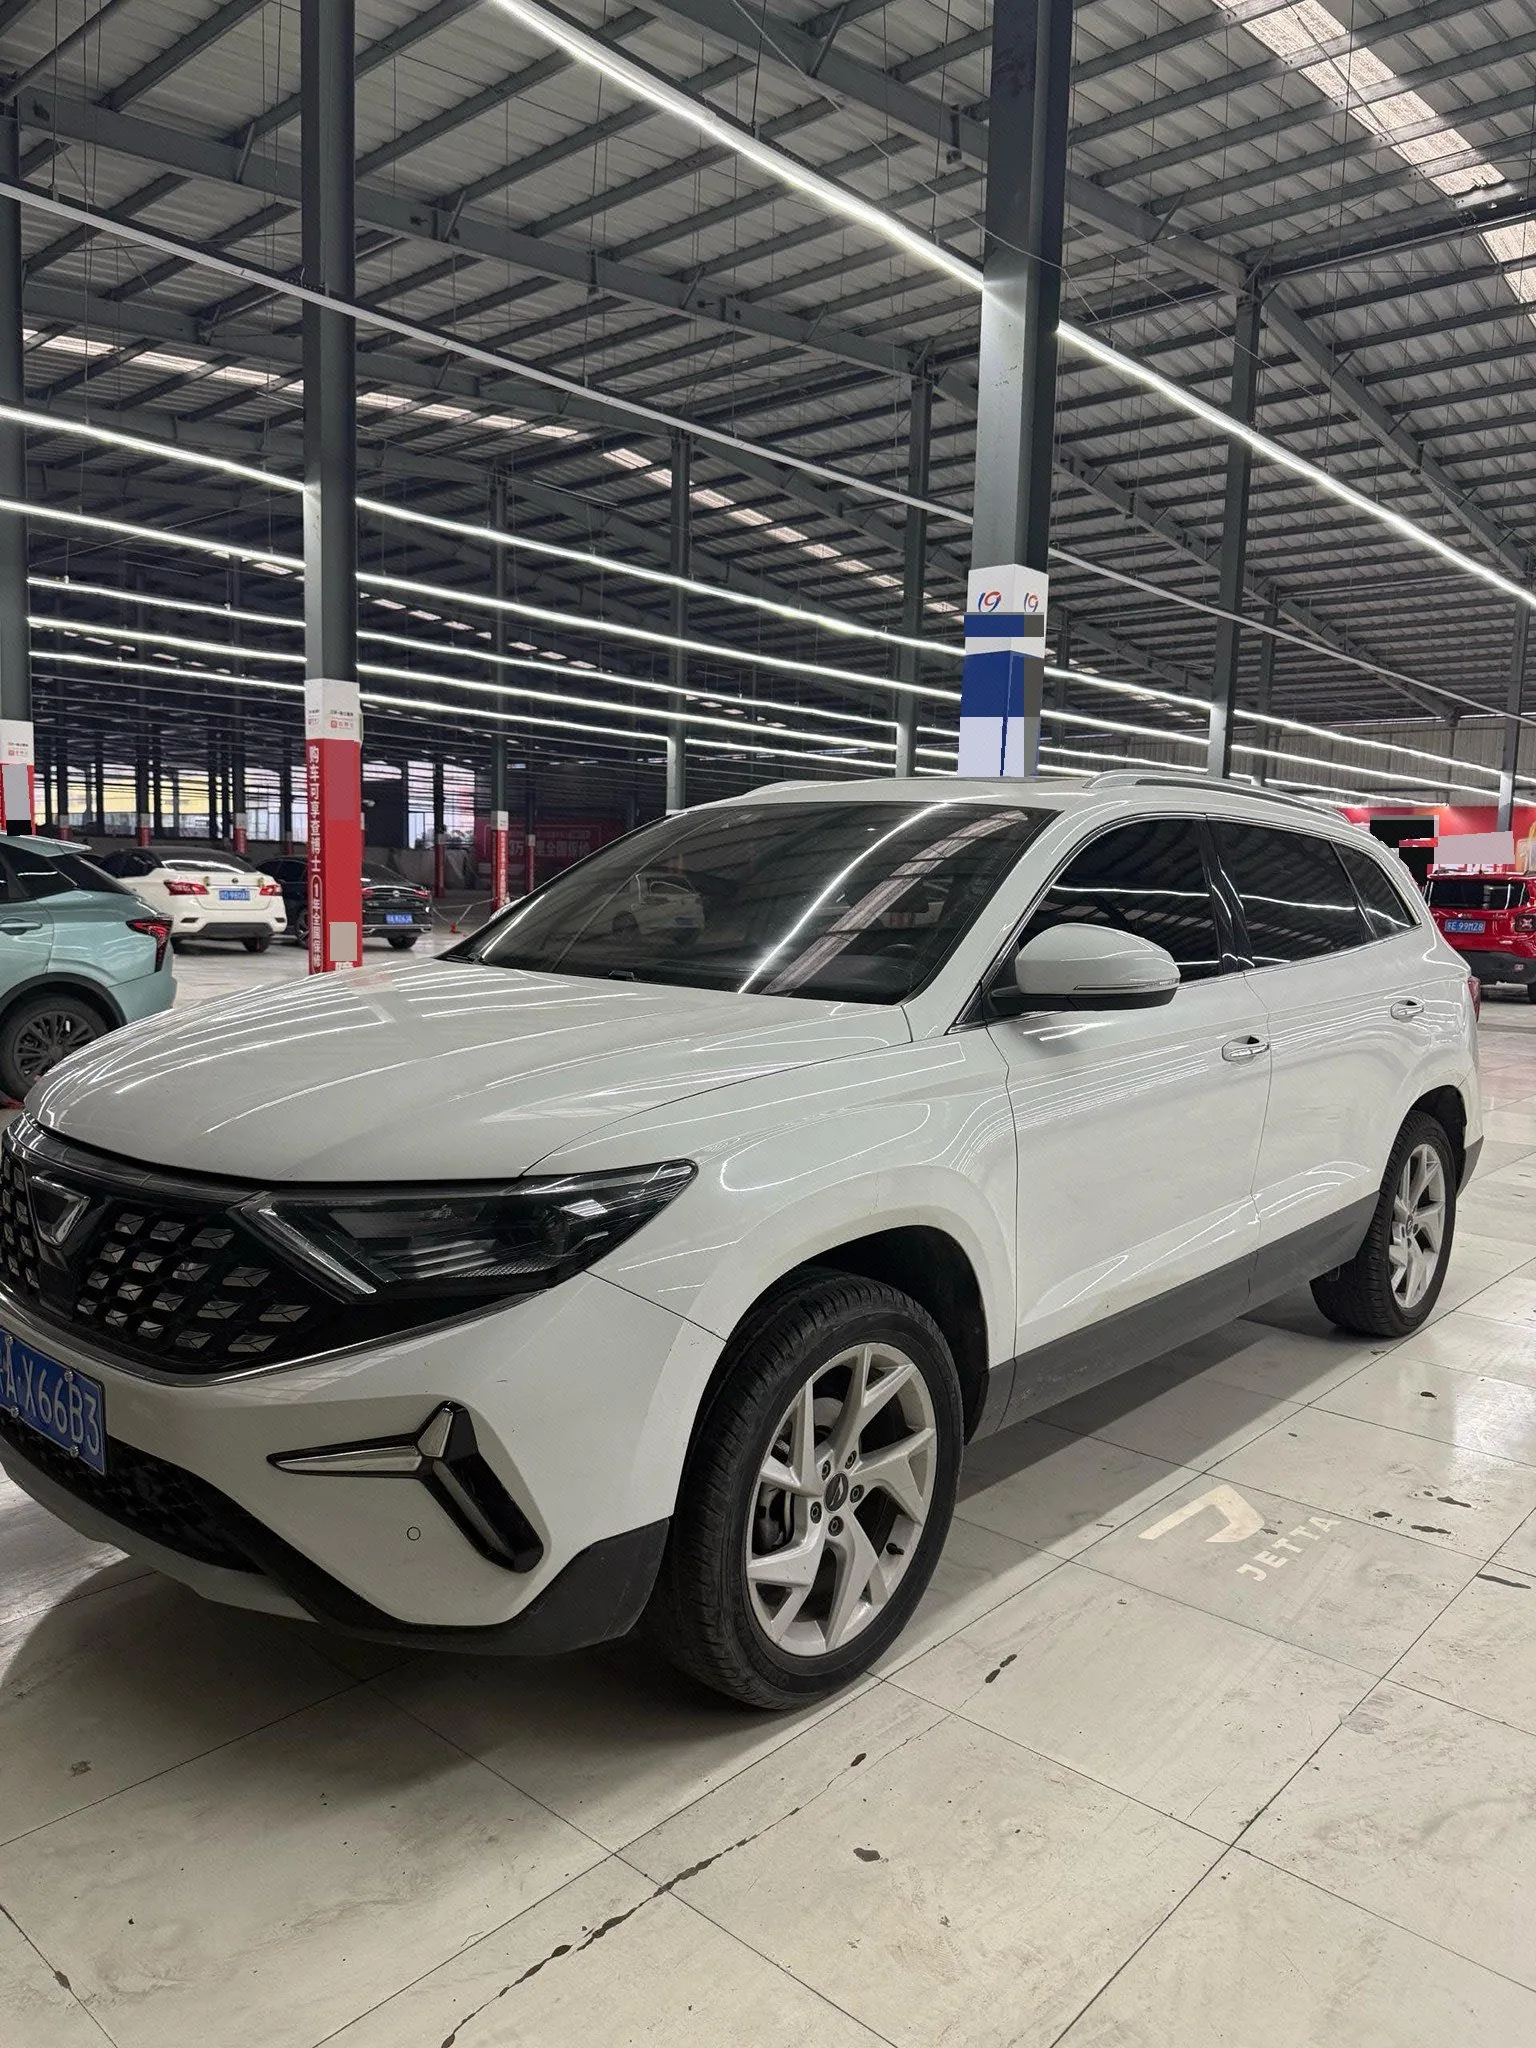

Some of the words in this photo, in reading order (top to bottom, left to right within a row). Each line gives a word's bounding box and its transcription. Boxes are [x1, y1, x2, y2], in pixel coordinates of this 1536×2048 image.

[309, 745, 321, 872] 购车可享查博士
[0, 1338, 100, 1456] A·X66B3
[1236, 1516, 1342, 1582] JETTA
